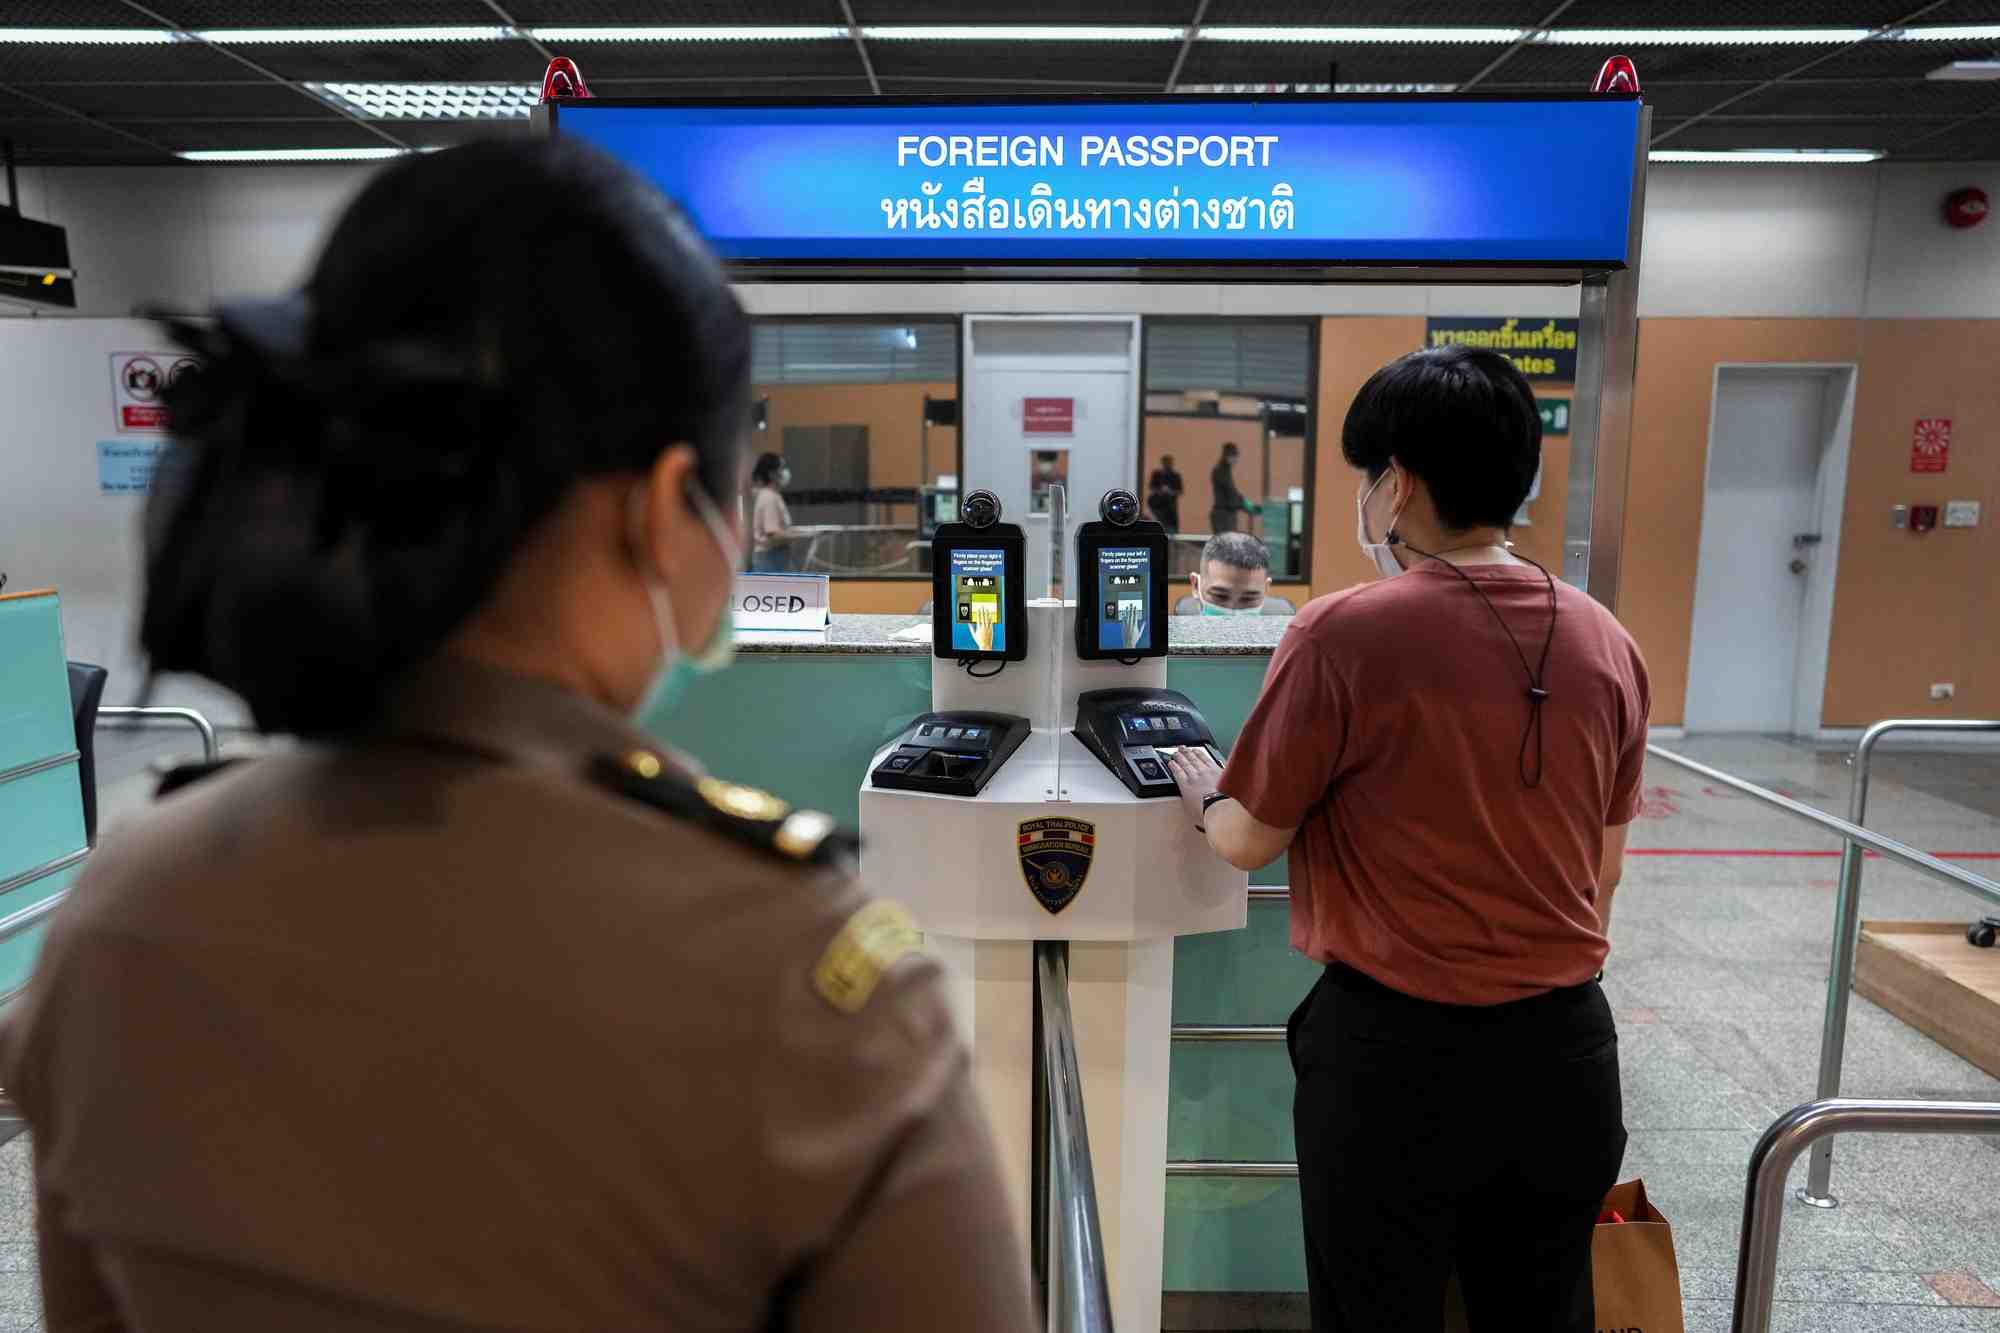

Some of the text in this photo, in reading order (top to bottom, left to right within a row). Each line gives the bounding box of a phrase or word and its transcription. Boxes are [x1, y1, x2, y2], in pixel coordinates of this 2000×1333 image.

[897, 135, 1279, 168] FOREIGN PASSPORT
[880, 176, 1295, 231] หนังสือเดินทางต่างชาติ
[1504, 353, 1555, 374] ates
[730, 594, 806, 613] LOSED
[1023, 822, 1045, 832] ROYAL
